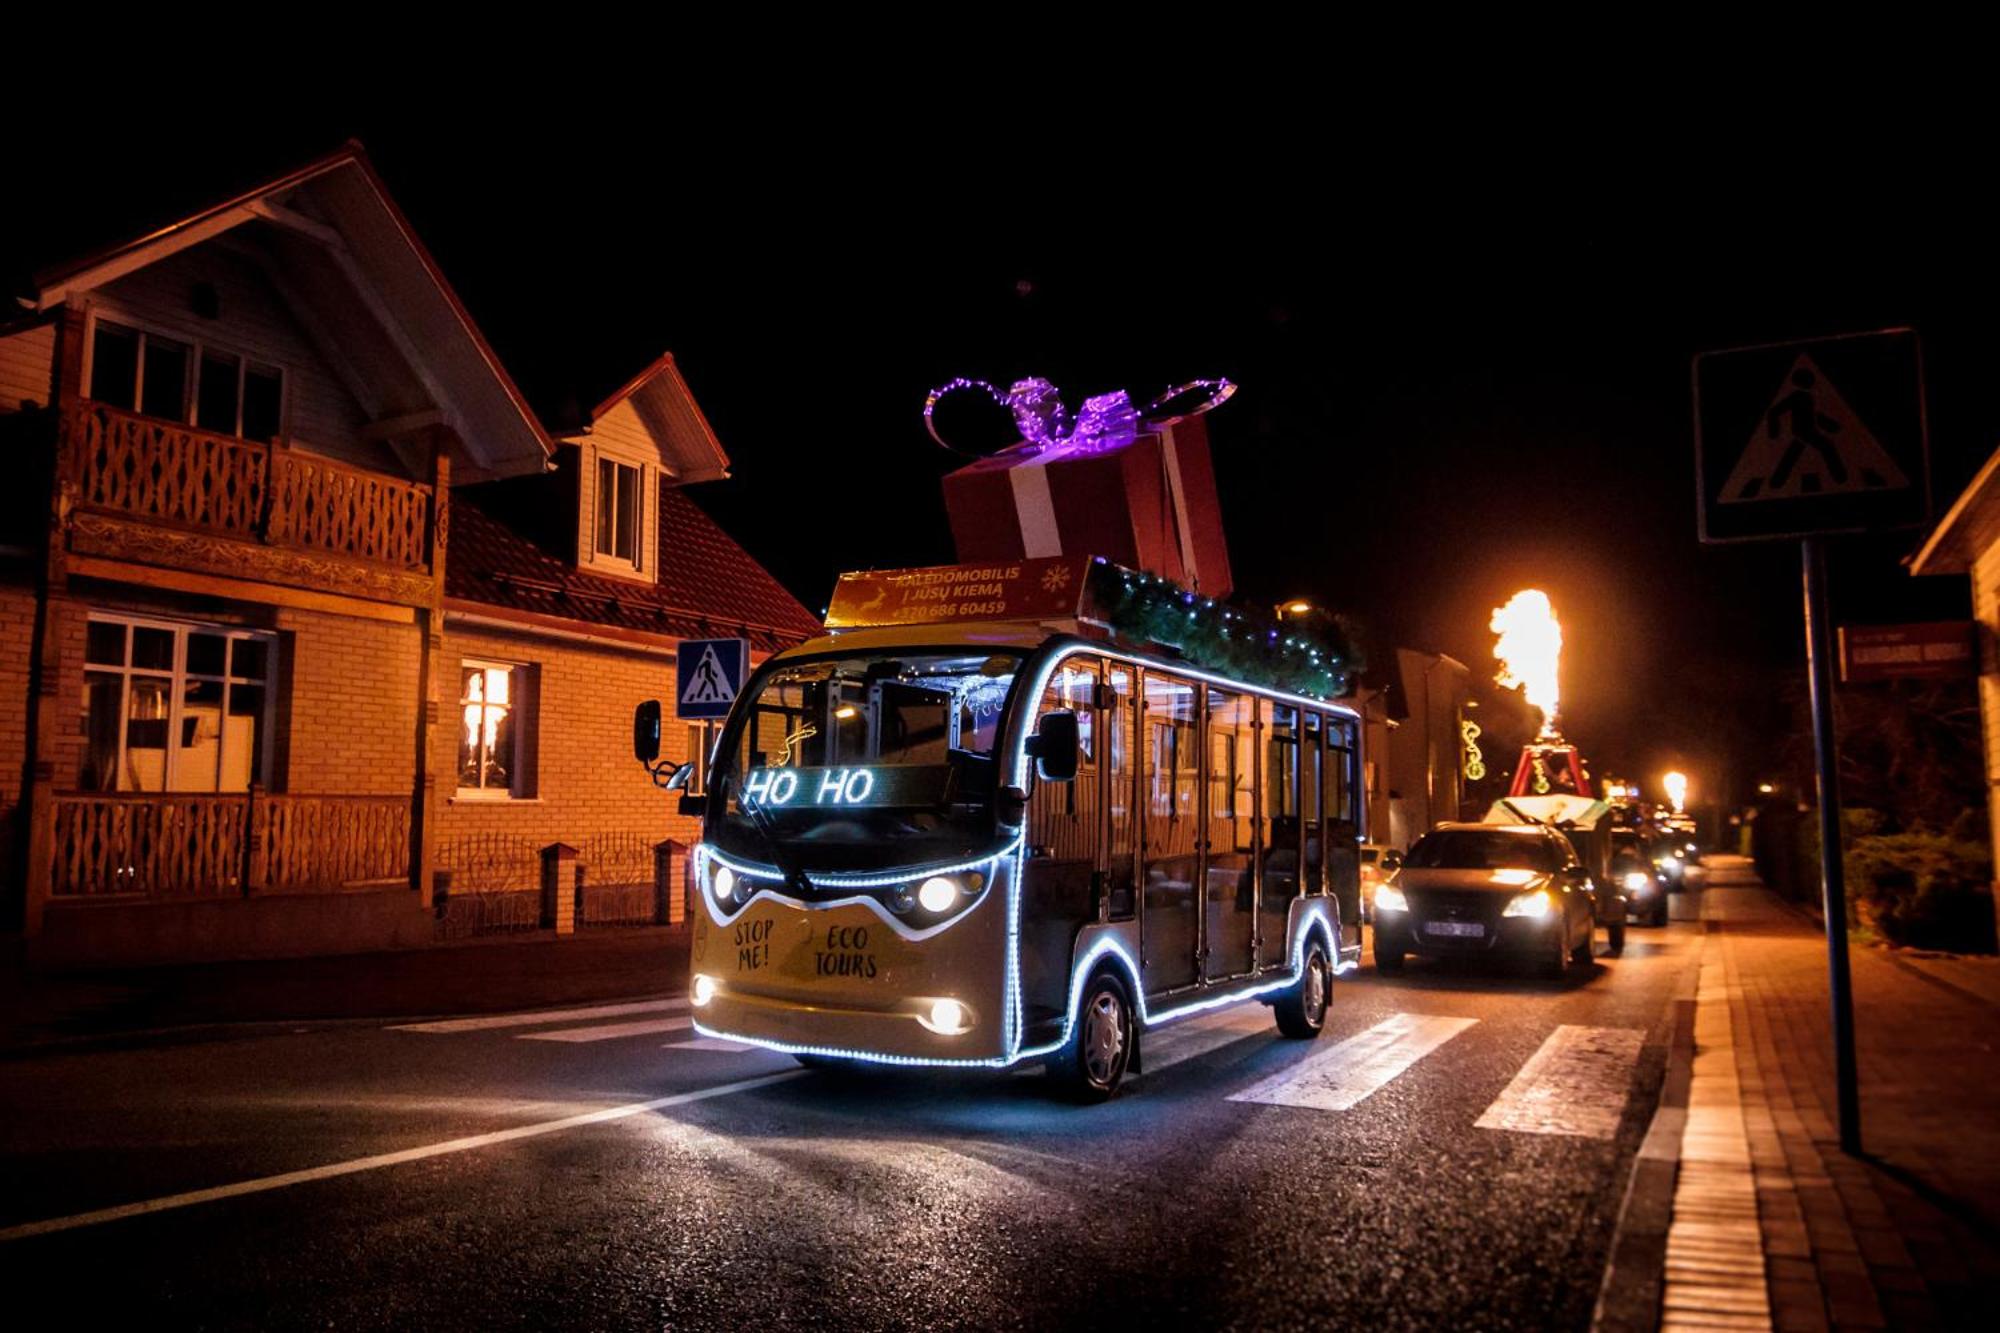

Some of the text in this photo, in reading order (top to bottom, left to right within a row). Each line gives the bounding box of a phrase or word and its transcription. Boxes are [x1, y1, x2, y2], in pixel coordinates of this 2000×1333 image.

[953, 583, 1003, 598] KIEMĄ
[929, 603, 956, 617] 686
[959, 601, 1006, 616] 60459
[743, 768, 874, 805] HO HO
[734, 919, 773, 947] STOP
[827, 926, 867, 950] ECO
[738, 944, 769, 971] ME!
[815, 952, 877, 978] TOURS
